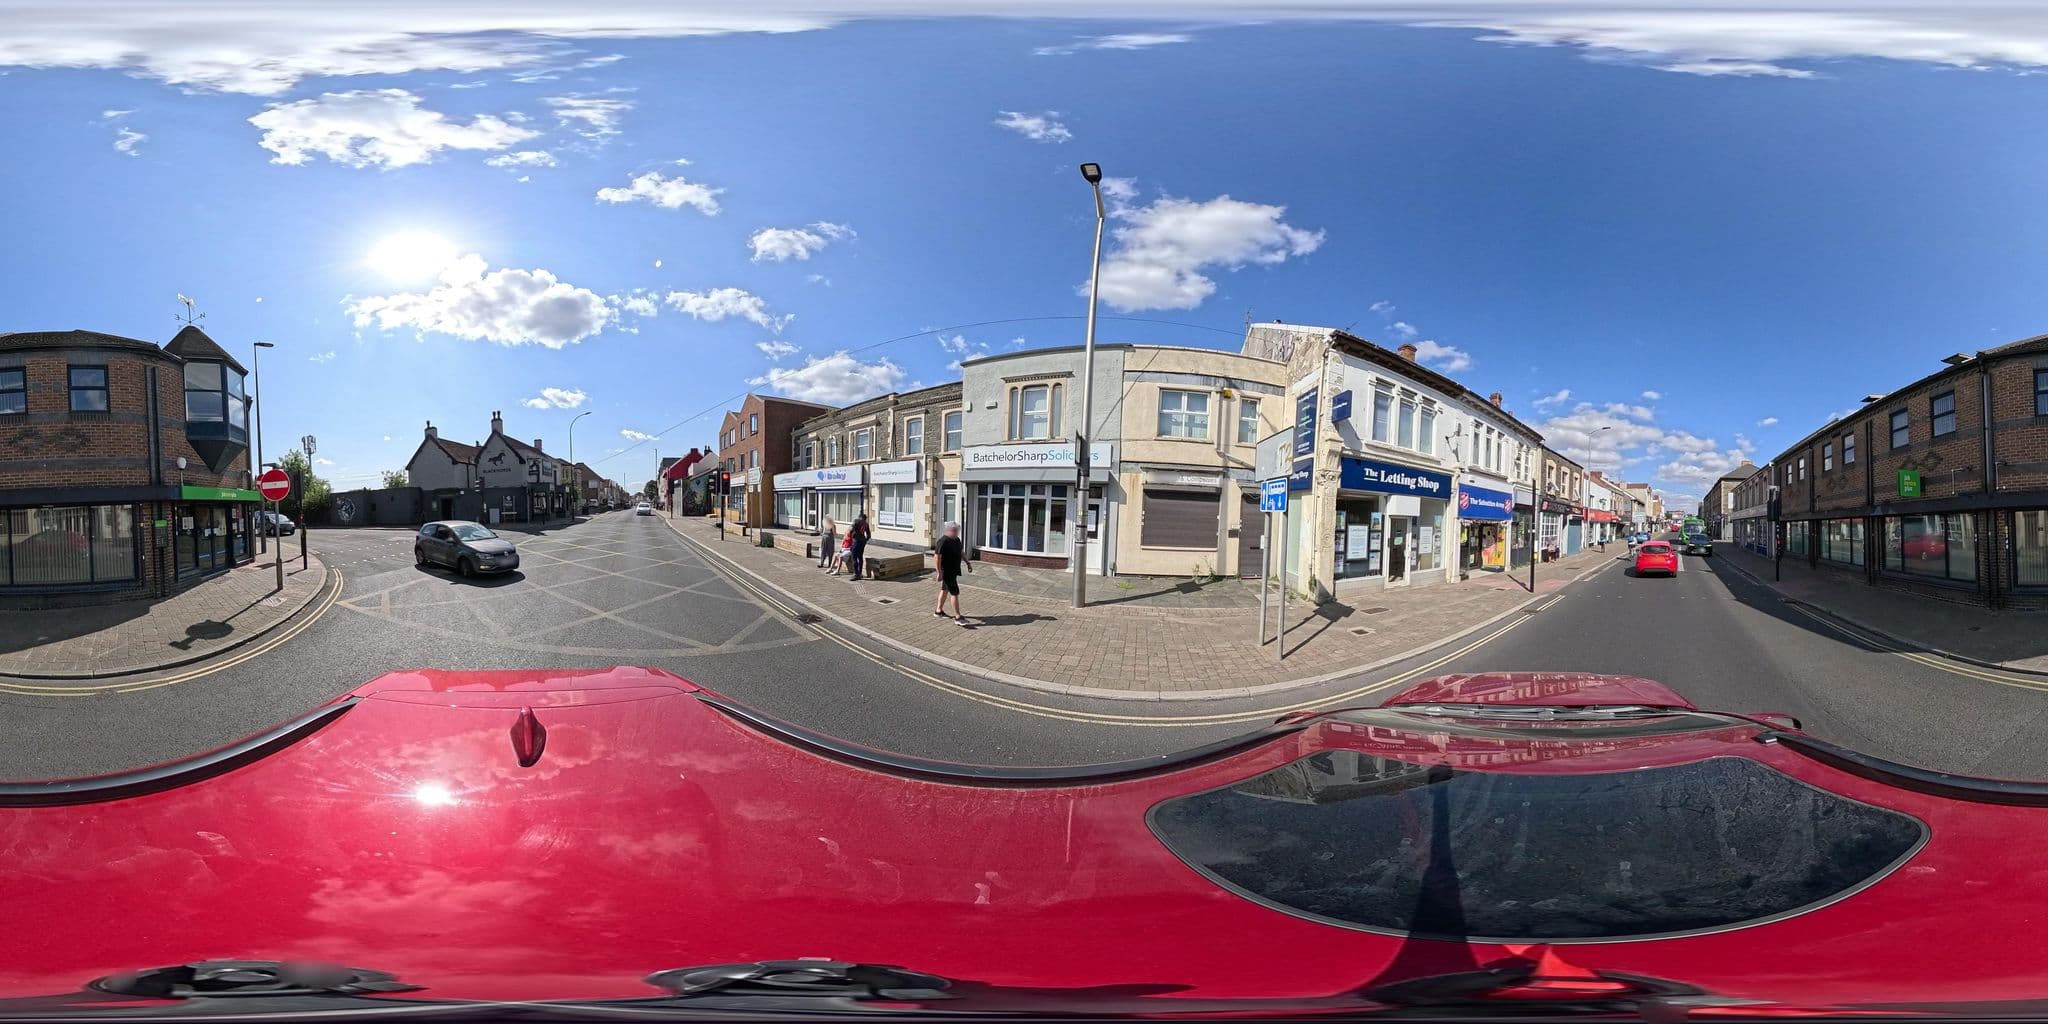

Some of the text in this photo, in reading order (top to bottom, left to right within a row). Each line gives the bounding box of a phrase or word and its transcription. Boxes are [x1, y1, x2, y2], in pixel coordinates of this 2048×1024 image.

[973, 449, 1099, 464] BatchelorSharpSolicrs
[1364, 467, 1440, 493] The Letting Shop
